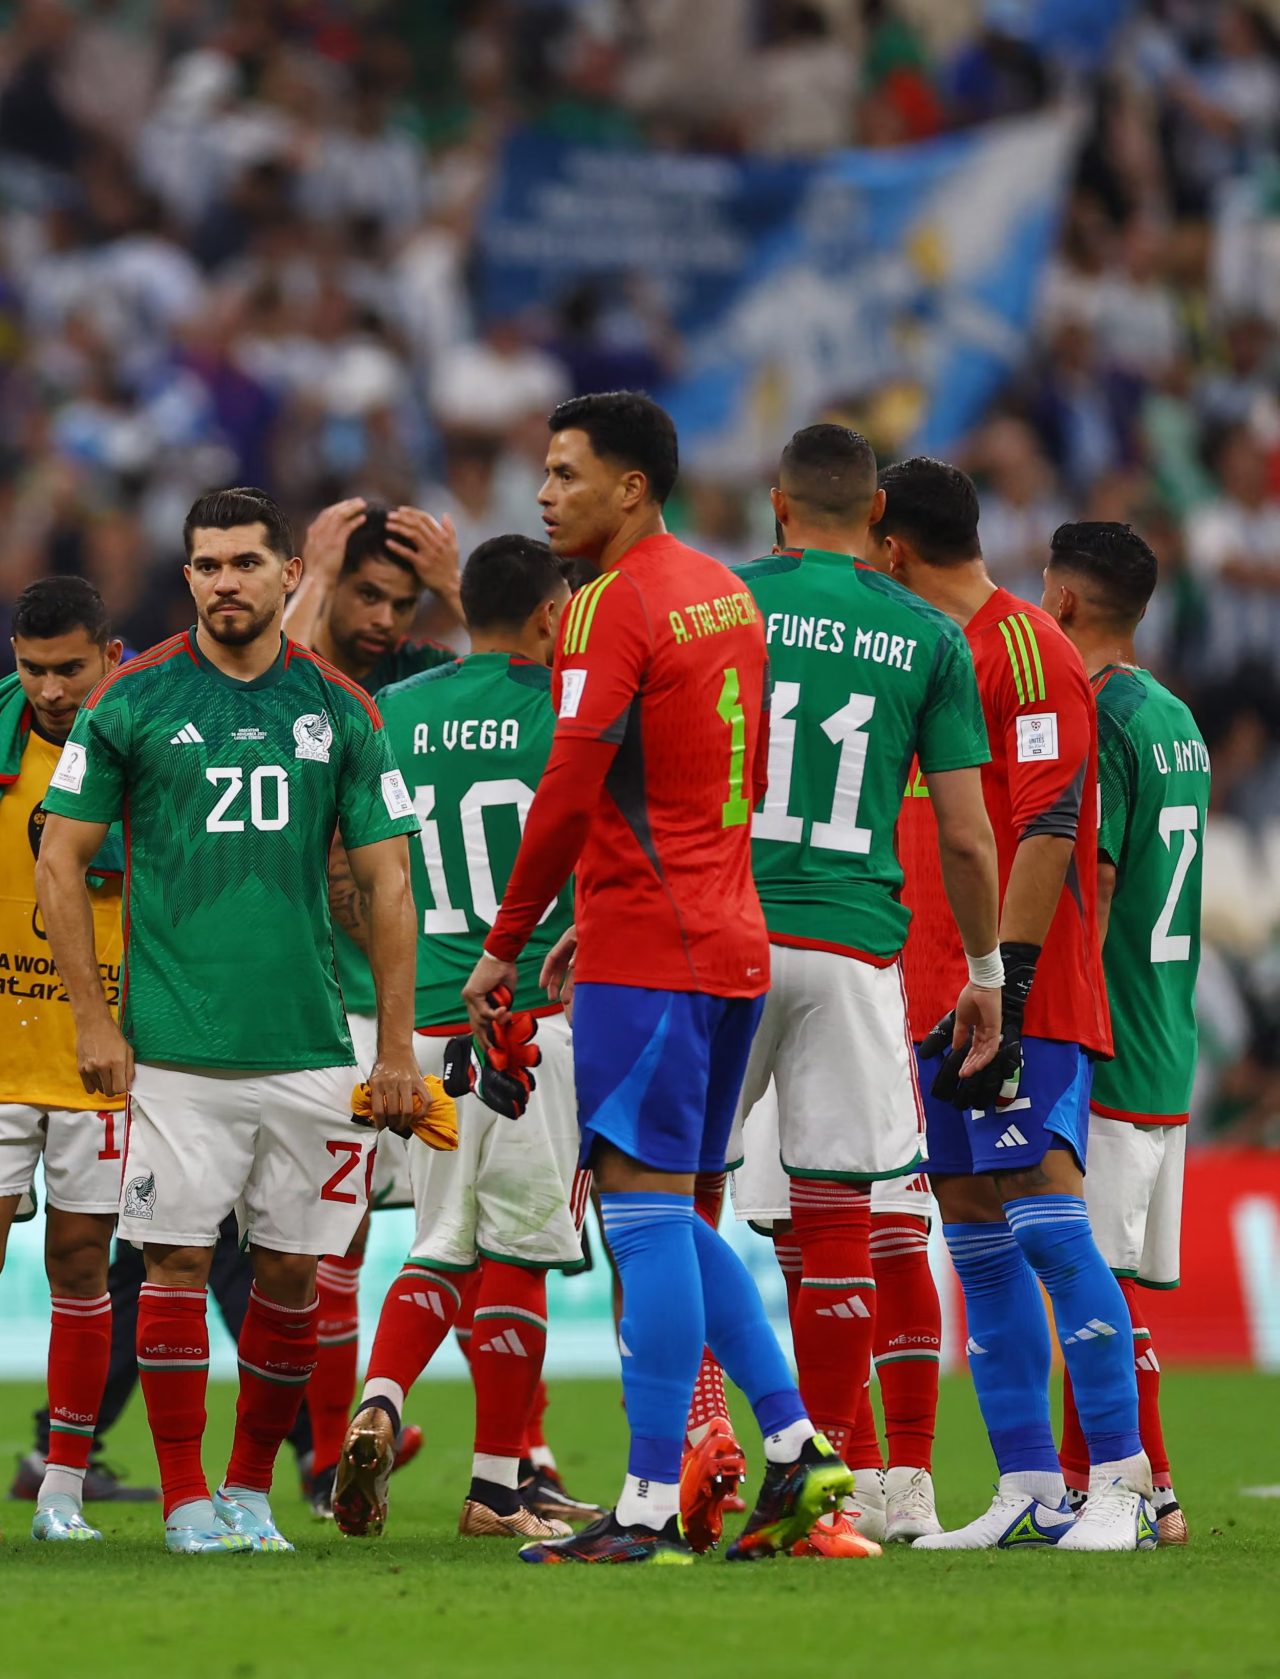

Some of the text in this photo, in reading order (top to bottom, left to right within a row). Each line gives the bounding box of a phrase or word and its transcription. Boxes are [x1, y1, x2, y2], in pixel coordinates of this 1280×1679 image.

[669, 611, 692, 644] A.
[766, 613, 917, 671] FUNES MORI
[413, 719, 519, 755] A. VEGA
[716, 668, 749, 829] 1
[750, 681, 876, 854] 11
[1153, 740, 1211, 775] U. ANTU
[206, 765, 289, 833] 20
[412, 779, 558, 934] 10
[1150, 805, 1208, 963] 2
